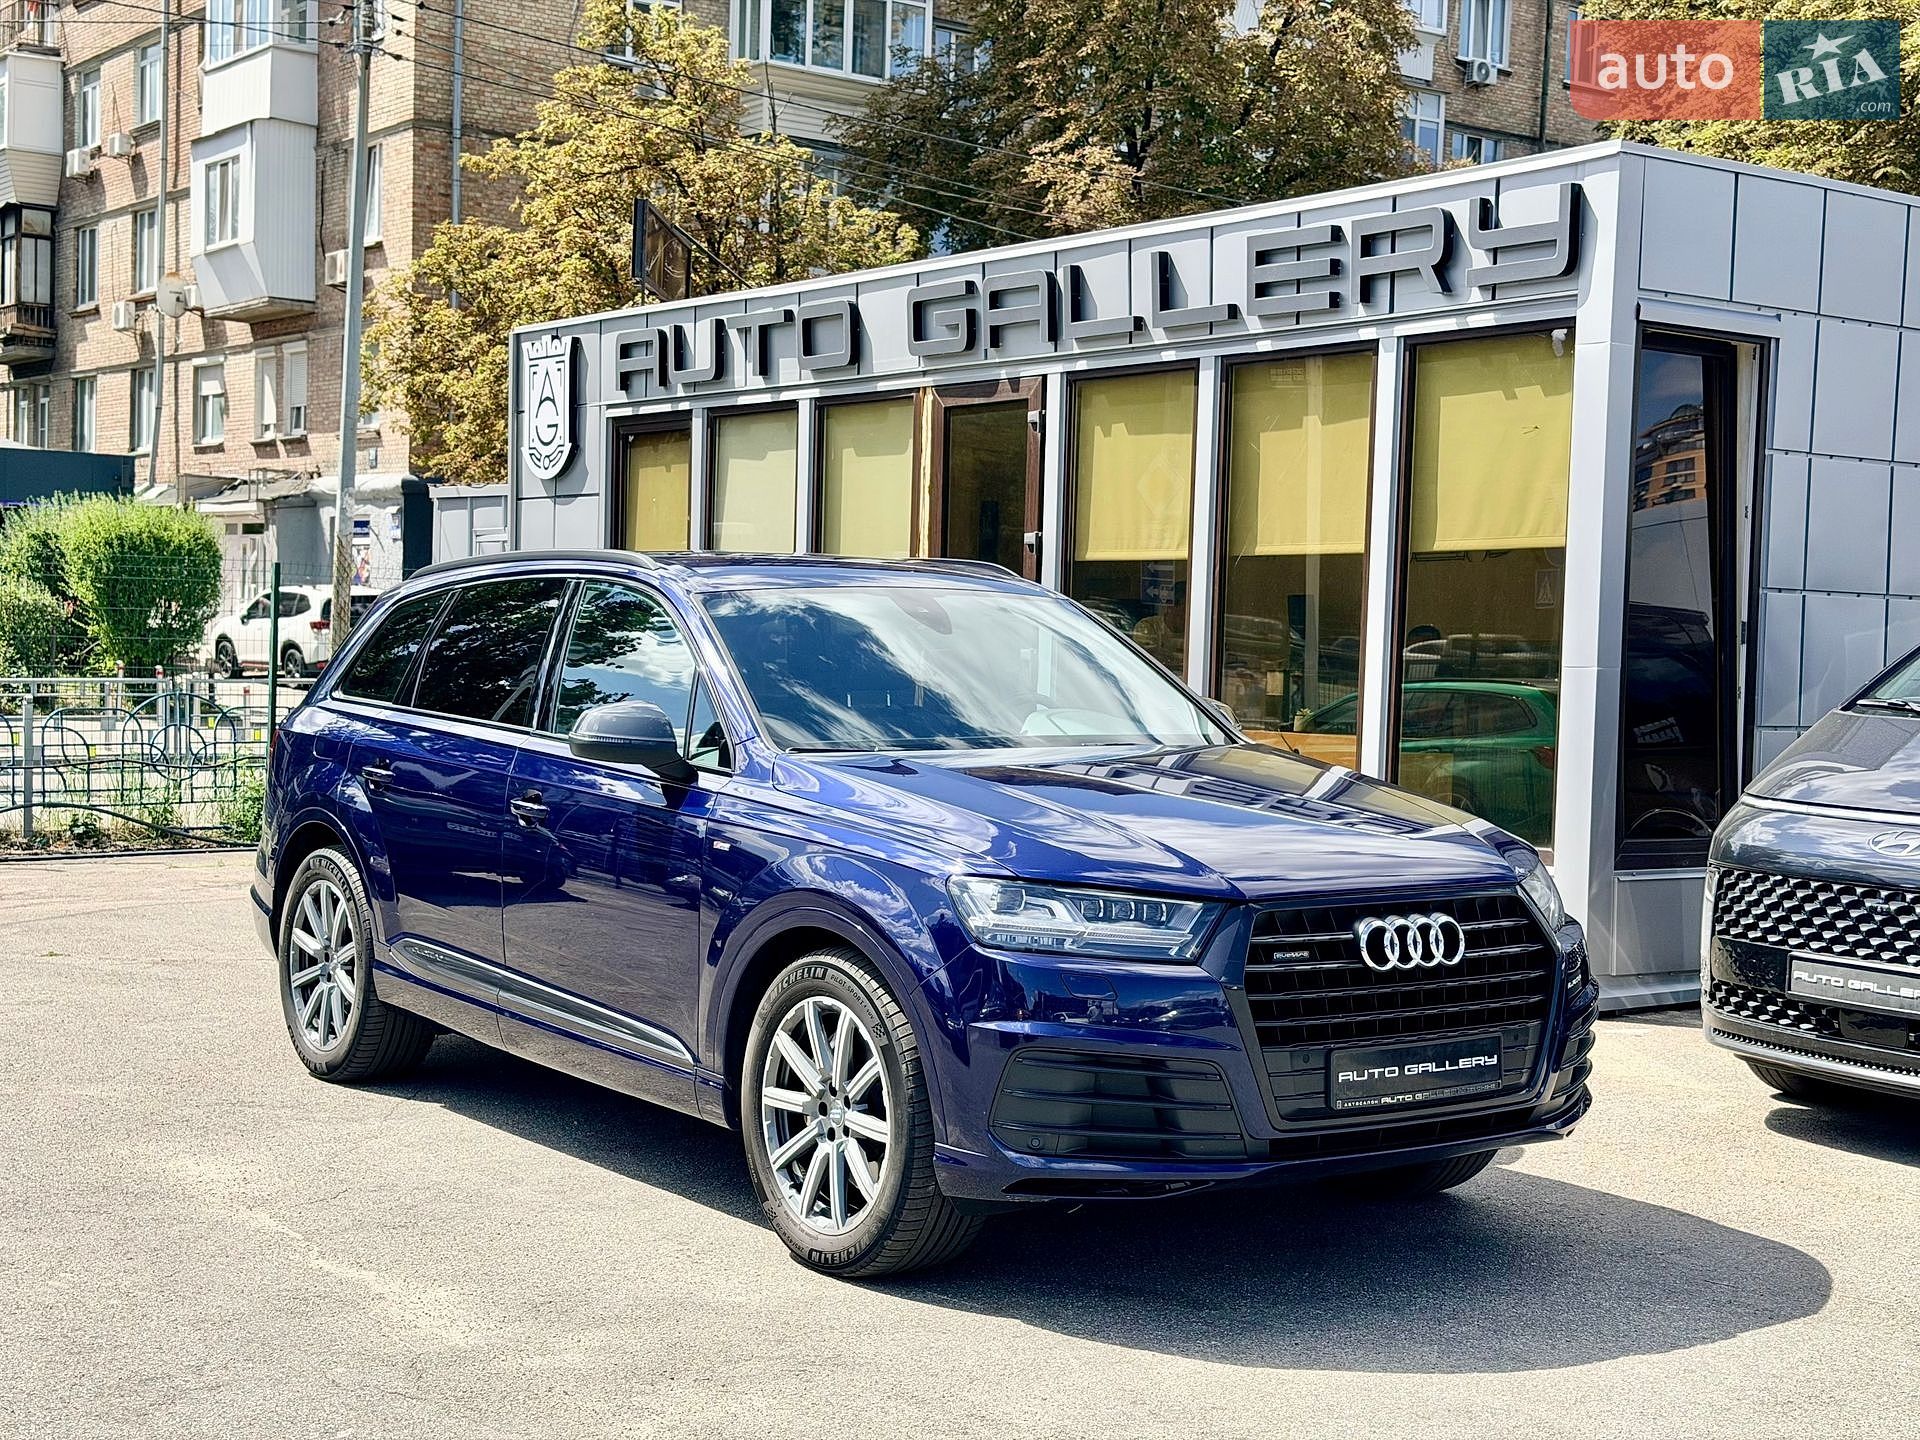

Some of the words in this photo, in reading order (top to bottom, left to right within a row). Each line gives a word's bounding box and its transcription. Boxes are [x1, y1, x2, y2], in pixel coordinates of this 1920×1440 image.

[615, 300, 861, 391] AUTO
[907, 182, 1581, 356] GALLERY
[770, 967, 824, 999] MICHELIN
[1793, 970, 1844, 988] AUTO
[1338, 1066, 1399, 1083] AUTO
[1404, 1054, 1498, 1075] GALLERY
[1381, 1095, 1412, 1104] AUTO
[811, 1238, 870, 1264] MICHELIN
